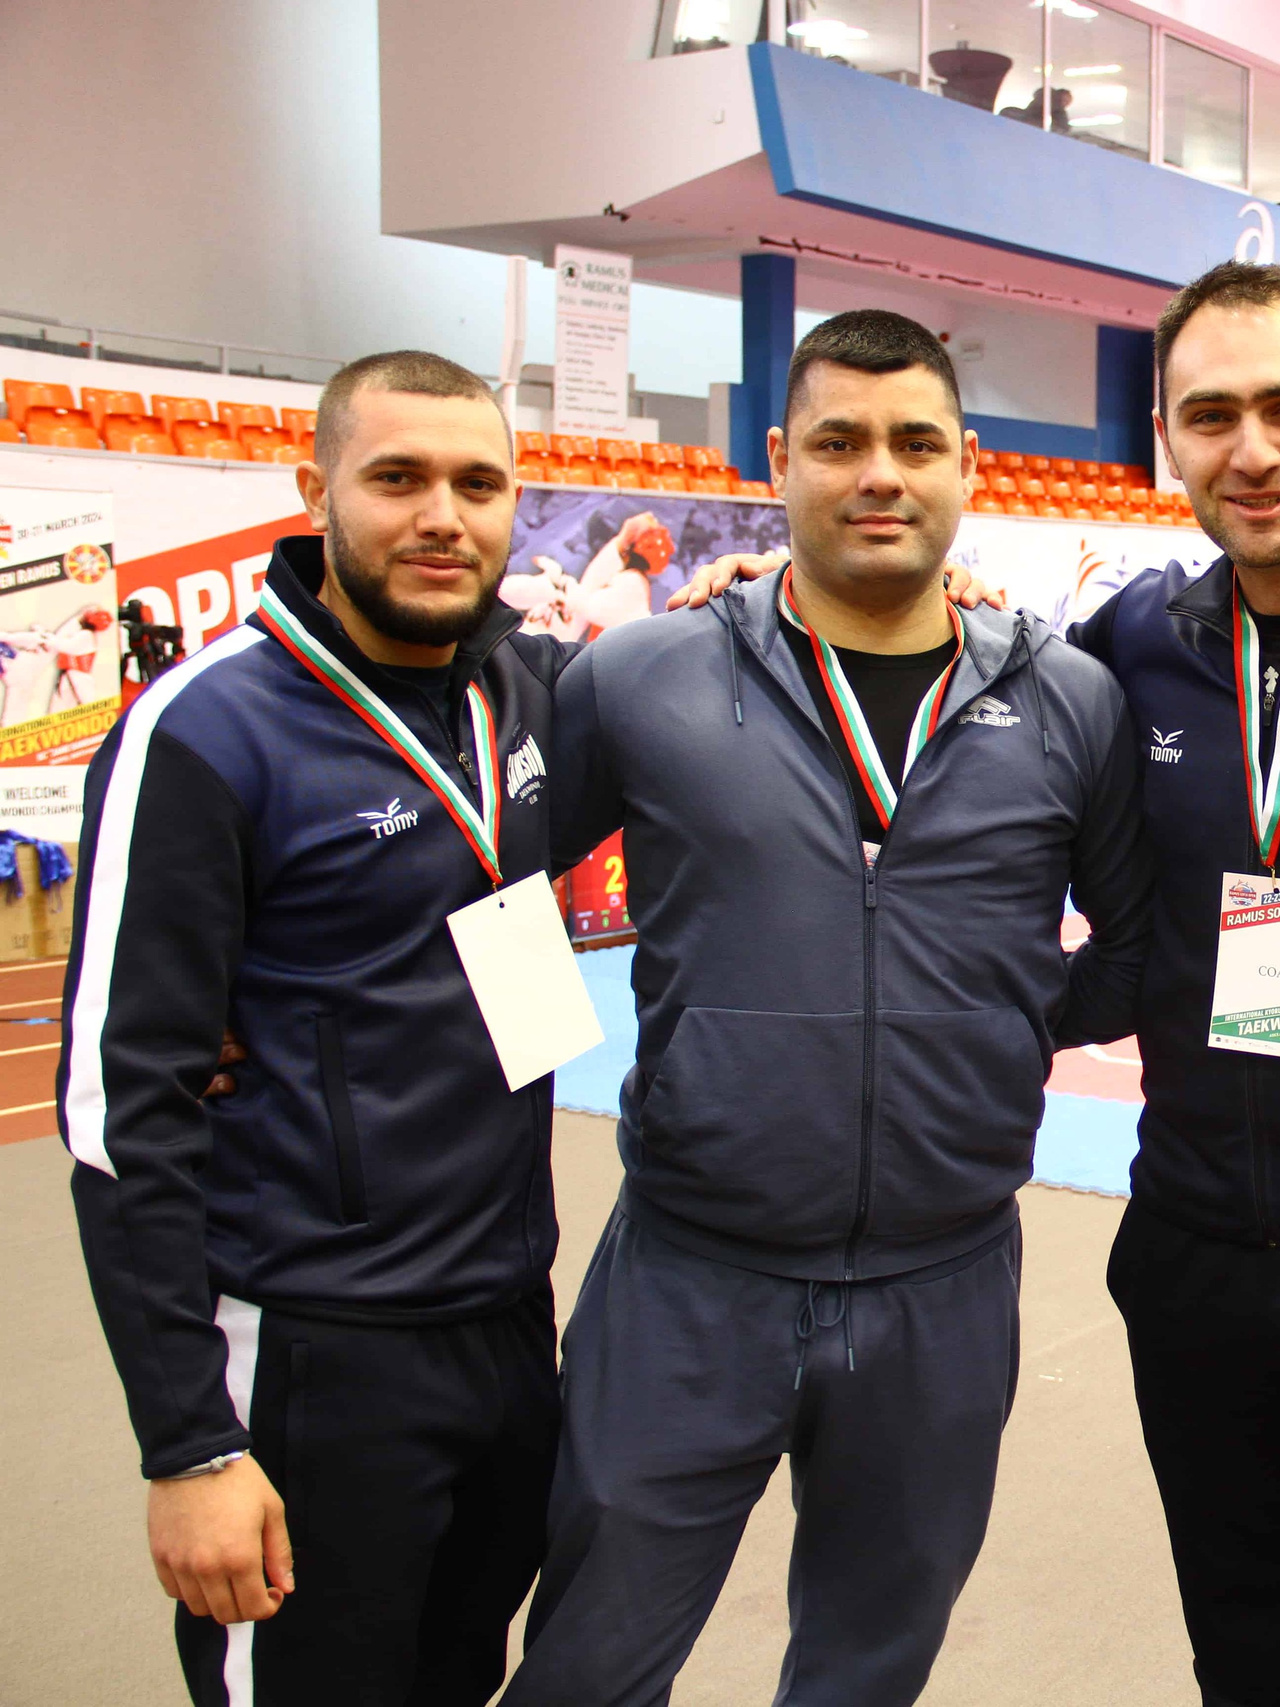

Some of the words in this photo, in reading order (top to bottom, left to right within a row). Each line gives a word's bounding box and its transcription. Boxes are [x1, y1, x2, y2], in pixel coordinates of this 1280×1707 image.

[16, 560, 61, 585] RAMUS
[0, 710, 118, 762] AEKWONDO
[507, 734, 547, 799] SAMSON
[1150, 745, 1183, 764] TOMY
[6, 784, 69, 801] WELCOME
[370, 810, 419, 840] TOMY
[605, 855, 624, 894] 2
[1227, 910, 1265, 926] RAMUS
[1224, 1010, 1264, 1022] INTERNATIONAL
